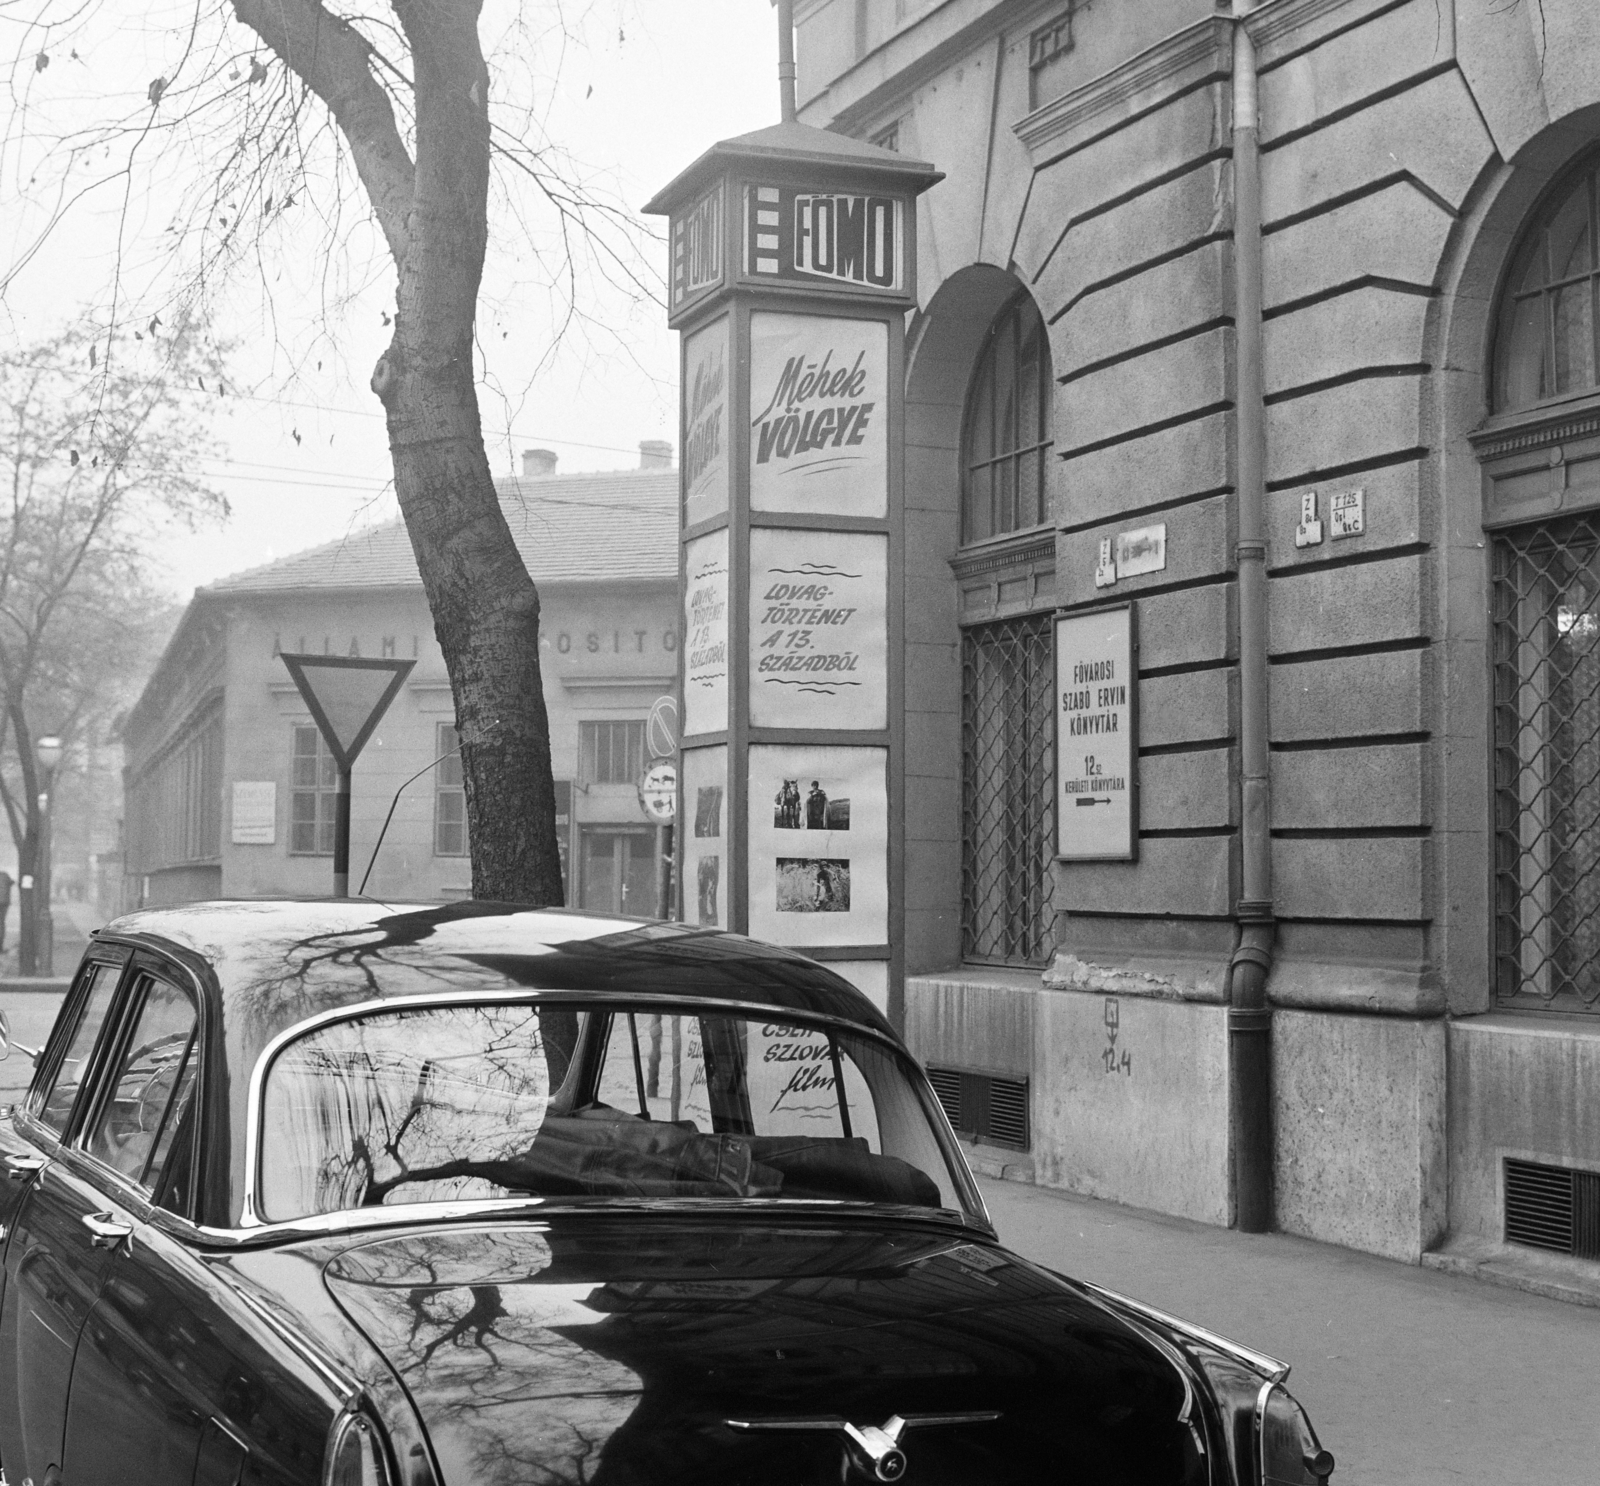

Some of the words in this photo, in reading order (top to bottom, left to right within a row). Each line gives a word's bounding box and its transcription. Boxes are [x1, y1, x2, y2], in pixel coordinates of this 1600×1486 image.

[752, 349, 866, 427] Méhek
[756, 402, 875, 465] VÖLGYE
[763, 583, 834, 601] LOVAG-
[761, 602, 857, 625] TÖRTÉNET
[760, 630, 784, 648] A
[785, 630, 815, 649] 13.
[758, 651, 859, 672] SZÁZADBÓL
[1063, 685, 1090, 712] SZABÓ
[1098, 685, 1125, 708] ERVIN
[1070, 709, 1118, 736] KÖNYVTÁR
[770, 1064, 835, 1113] film
